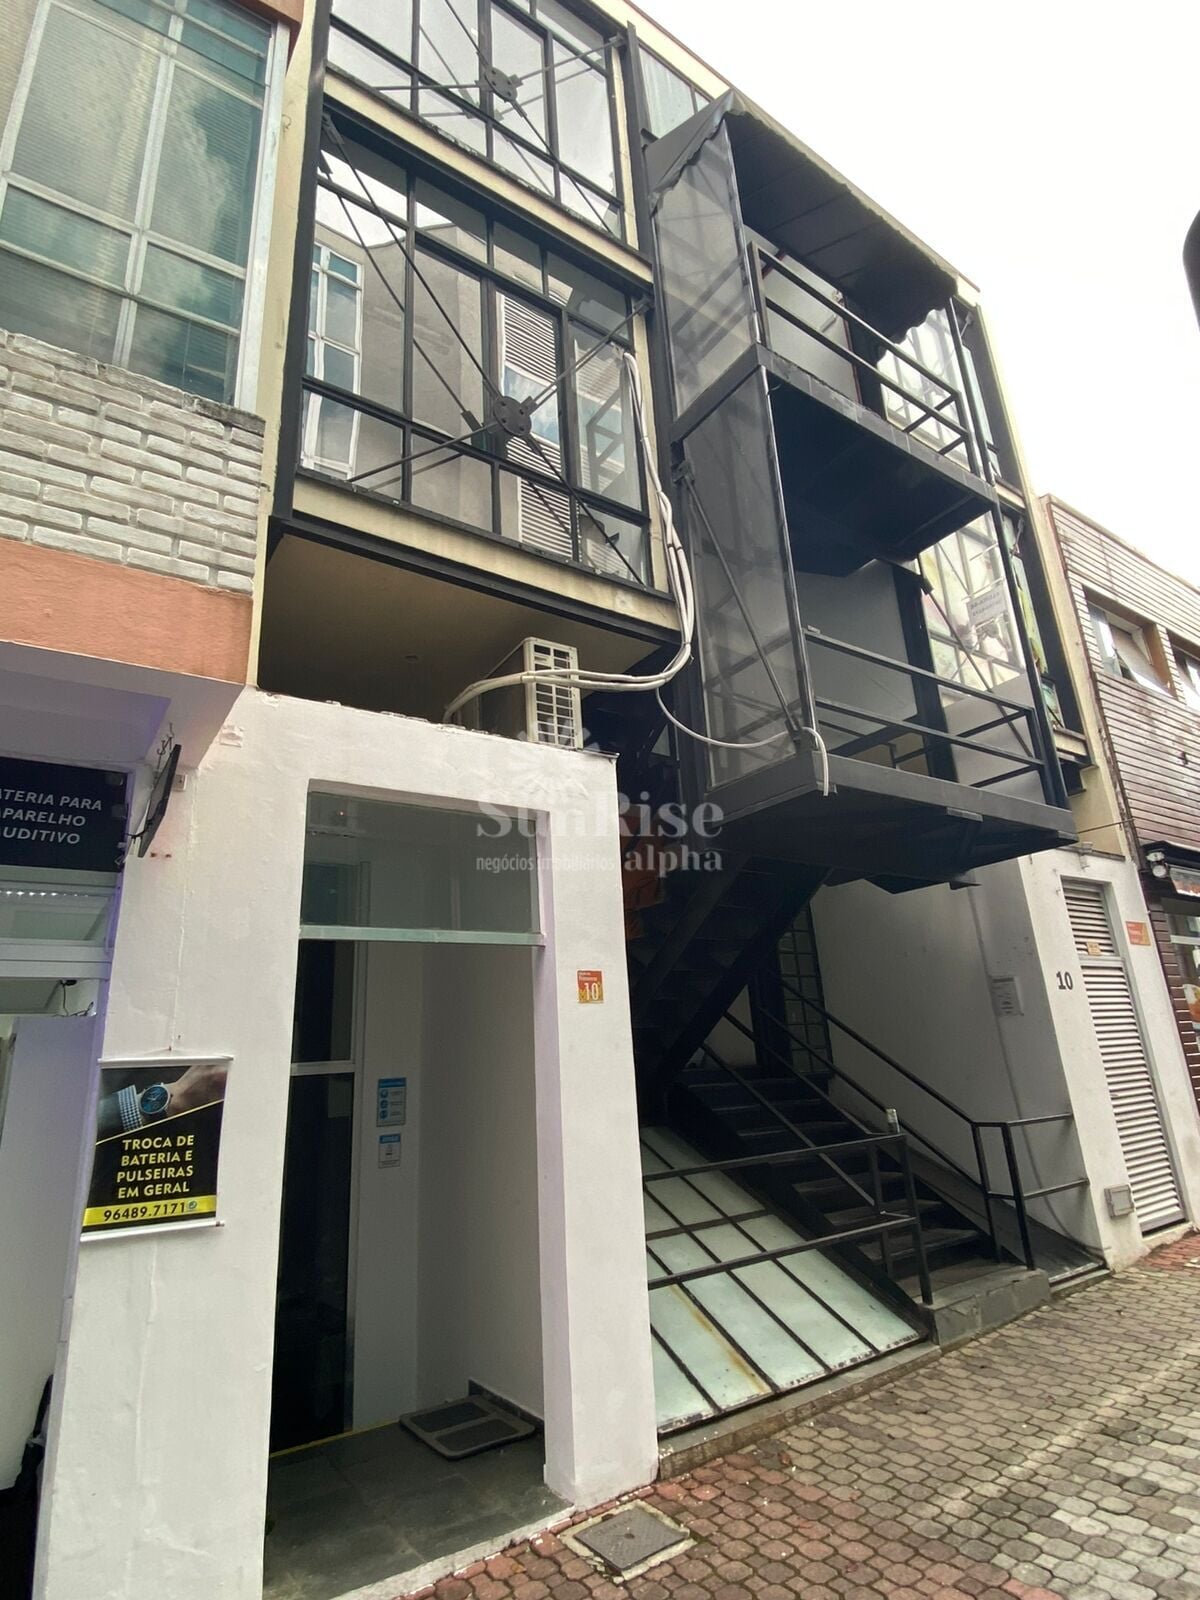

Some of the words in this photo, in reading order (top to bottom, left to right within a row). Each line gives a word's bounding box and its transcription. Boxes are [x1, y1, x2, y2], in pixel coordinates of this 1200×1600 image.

[0, 788, 54, 806] TERIA
[59, 795, 102, 811] PARA
[1056, 970, 1074, 990] 10
[584, 982, 599, 1001] 10
[122, 1136, 172, 1150] TROCA
[176, 1134, 195, 1147] DE
[121, 1151, 181, 1167] BATERIA
[184, 1150, 193, 1162] E
[116, 1165, 194, 1183] PULSEIRAS
[117, 1187, 139, 1199] EM
[143, 1181, 190, 1197] GERAL
[103, 1201, 186, 1222] 96489.7171
